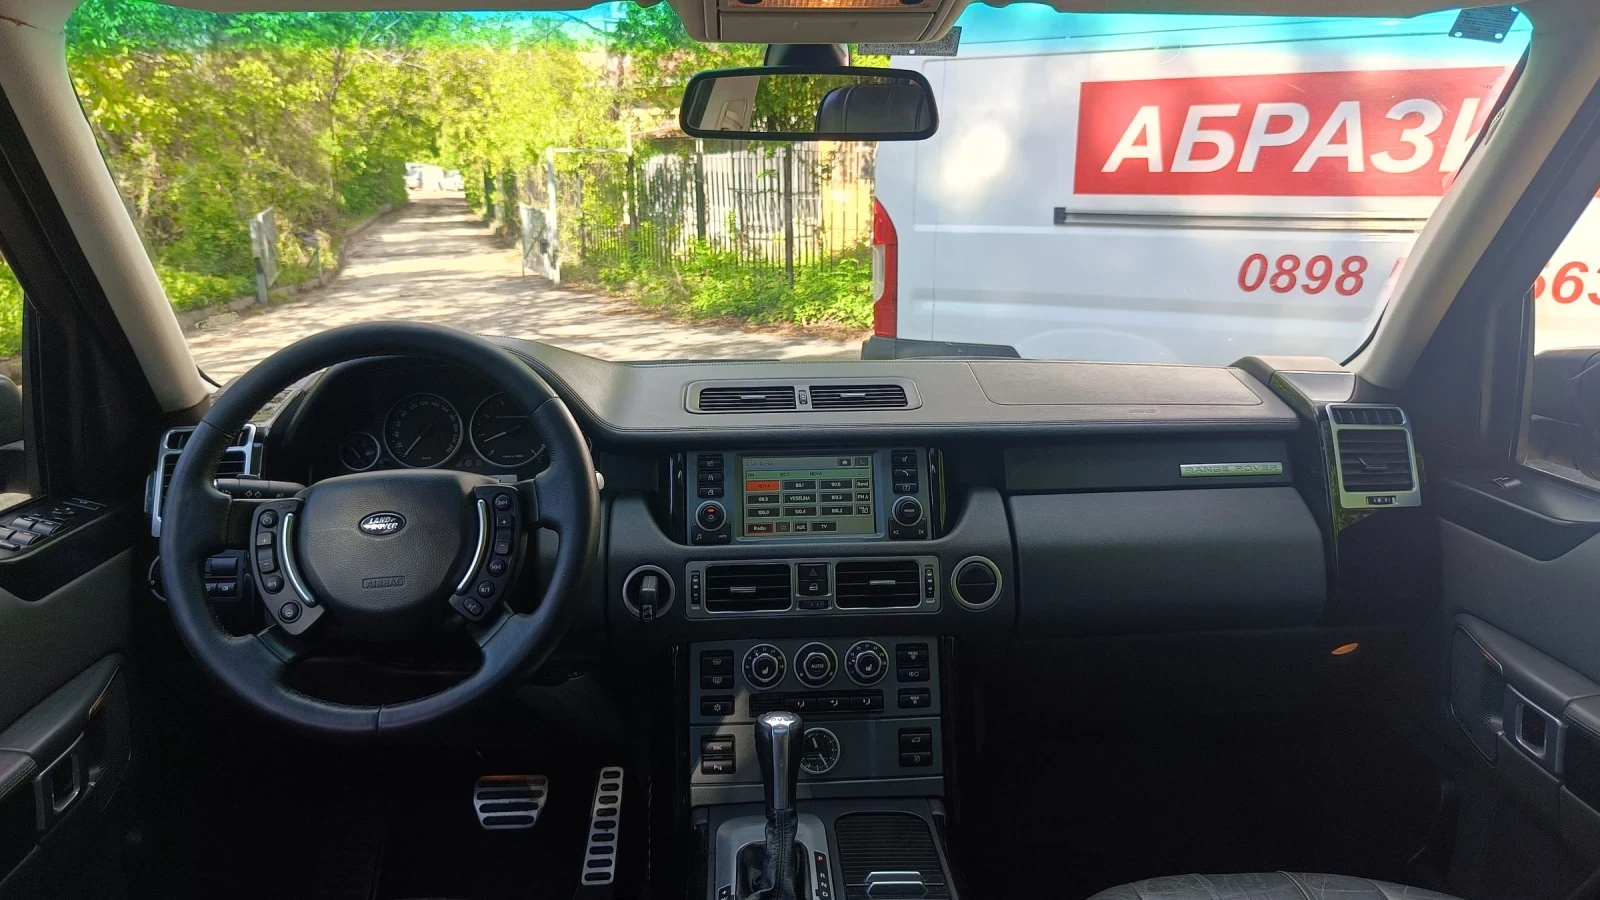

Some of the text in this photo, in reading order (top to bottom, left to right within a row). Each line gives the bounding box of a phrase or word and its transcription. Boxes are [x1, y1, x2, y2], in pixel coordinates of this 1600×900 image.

[1237, 253, 1369, 297] 0898
[1184, 463, 1278, 475] RANGE ROVER
[369, 516, 391, 524] LAND
[371, 522, 398, 531] ROVER
[366, 577, 404, 589] AIRBAG
